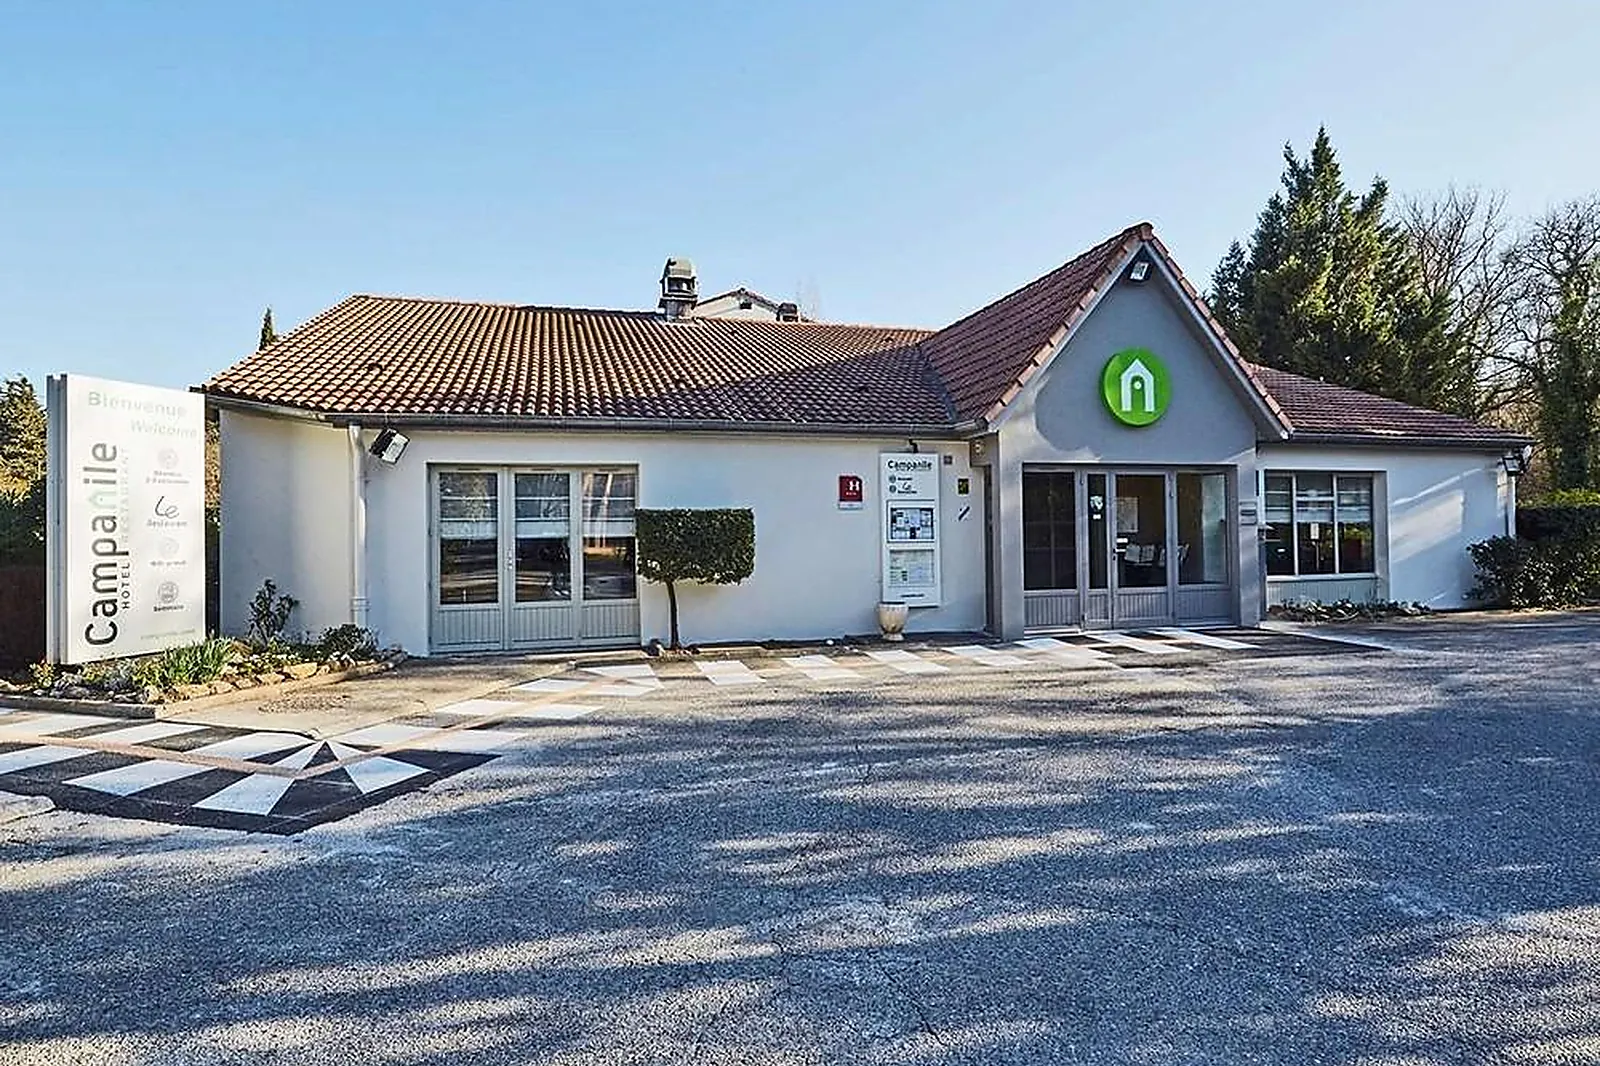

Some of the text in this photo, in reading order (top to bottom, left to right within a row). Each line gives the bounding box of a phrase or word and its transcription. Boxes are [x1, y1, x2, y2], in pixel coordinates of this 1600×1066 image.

[87, 390, 188, 418] Bienvenue
[130, 418, 198, 440] Welcome
[887, 459, 932, 471] Campanile
[154, 495, 181, 519] Le
[82, 442, 130, 646] Campanile
[121, 562, 131, 610] HOTEL
